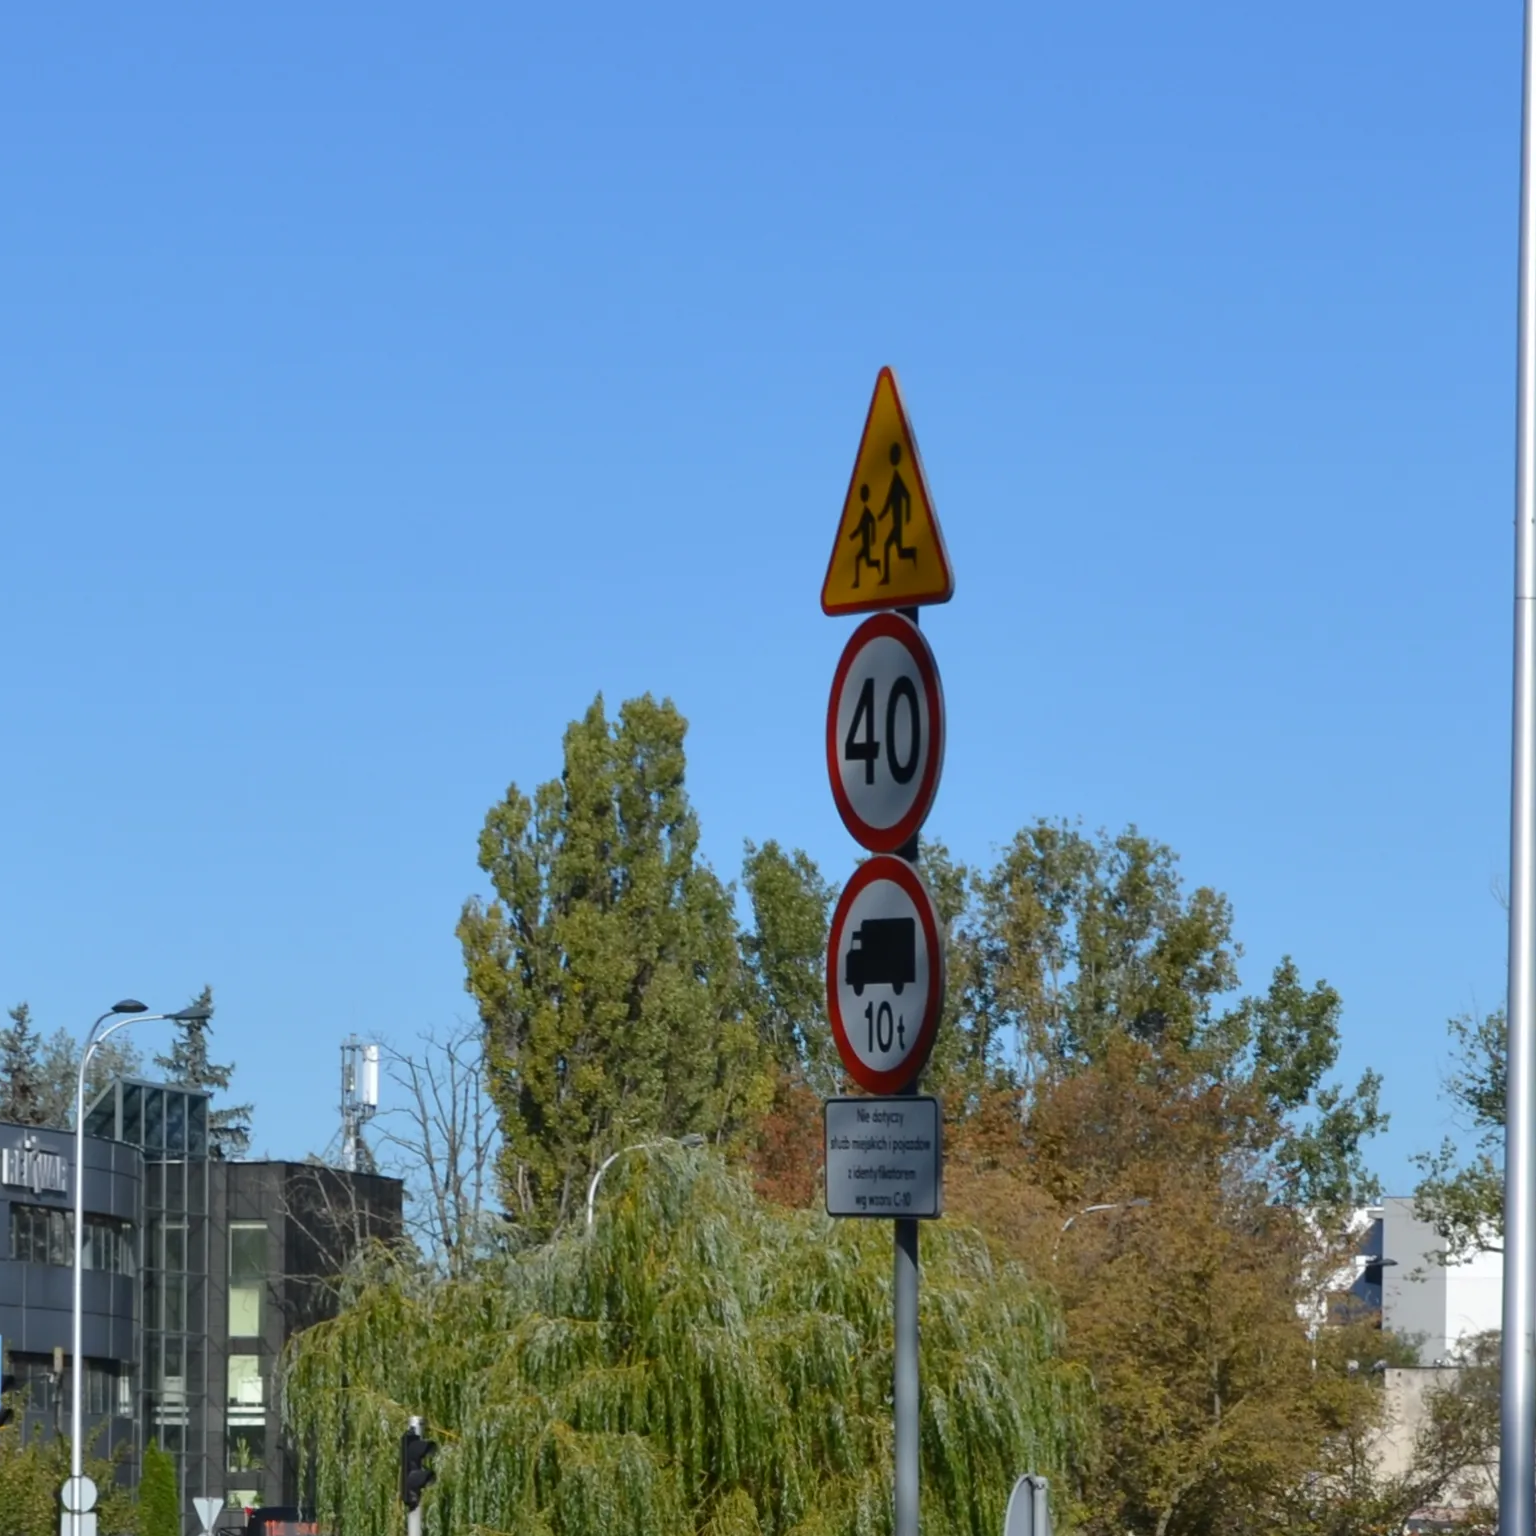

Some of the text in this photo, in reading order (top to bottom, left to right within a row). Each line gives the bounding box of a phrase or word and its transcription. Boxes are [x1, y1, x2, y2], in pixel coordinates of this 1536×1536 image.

[845, 675, 922, 785] 40
[857, 1108, 904, 1128] Nie dotyczy
[853, 1165, 916, 1184] identyfikatorem
